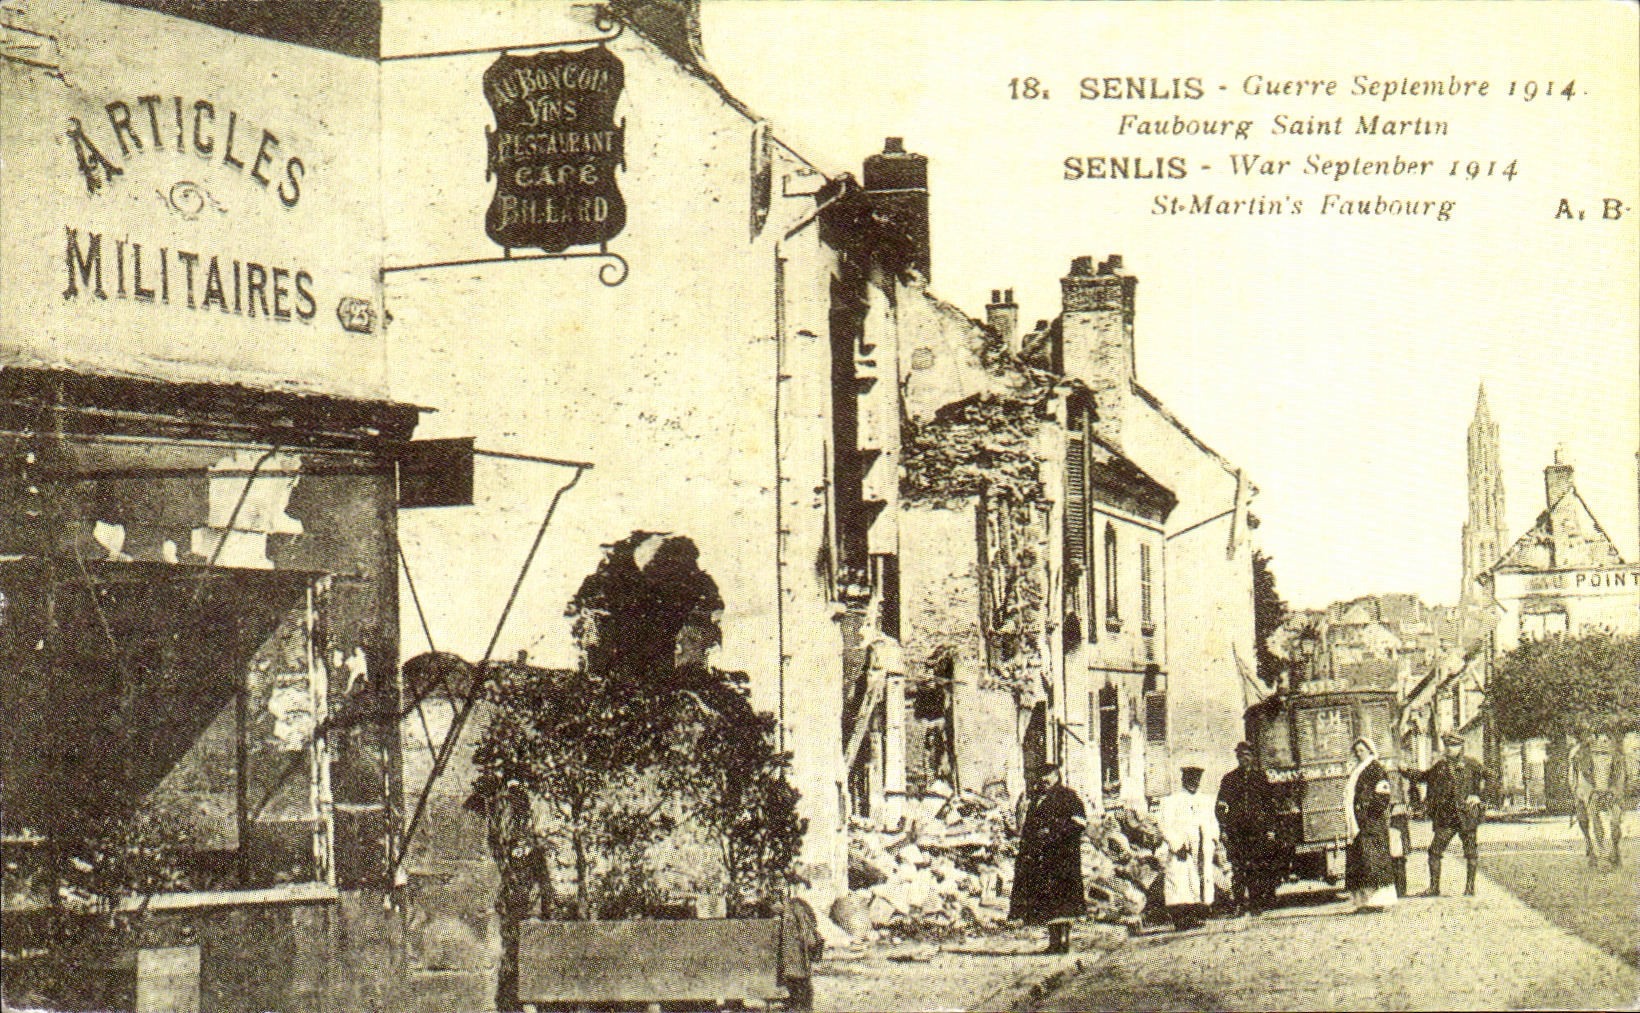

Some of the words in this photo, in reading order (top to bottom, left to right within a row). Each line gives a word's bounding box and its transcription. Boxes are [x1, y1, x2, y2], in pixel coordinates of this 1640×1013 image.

[519, 95, 577, 127] VINS
[66, 94, 306, 207] ARTICLES
[62, 223, 318, 325] MILITAIRES
[1576, 572, 1640, 588] POINT
